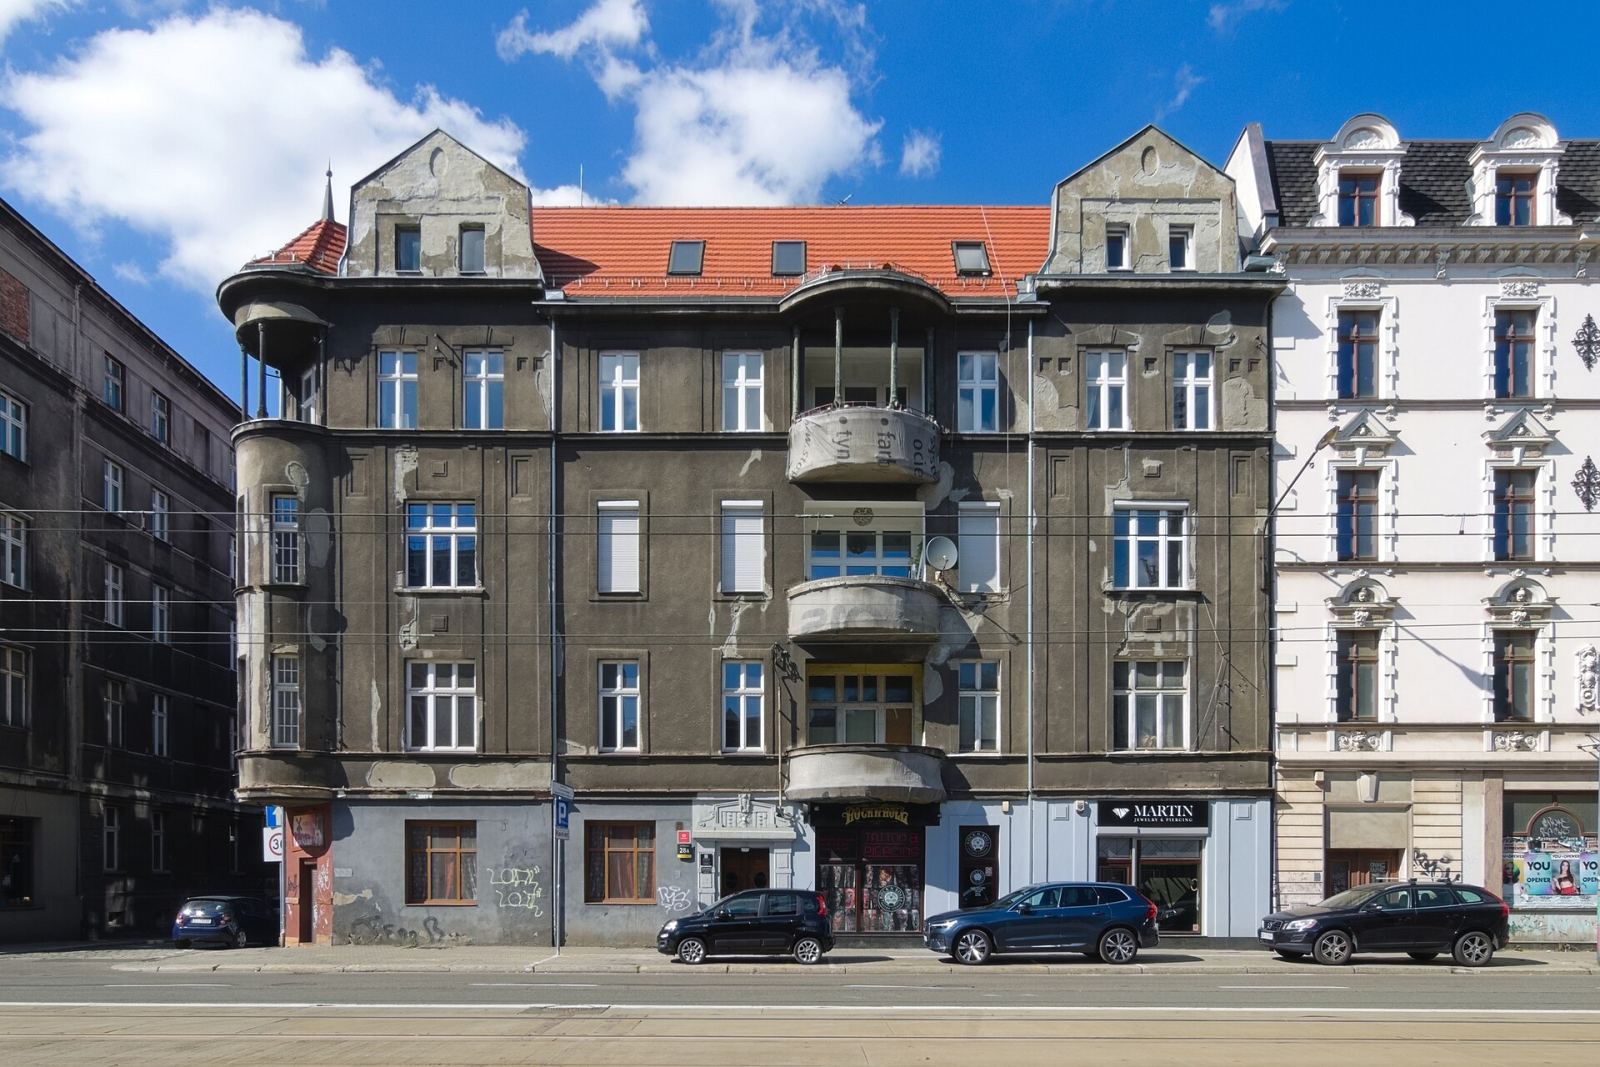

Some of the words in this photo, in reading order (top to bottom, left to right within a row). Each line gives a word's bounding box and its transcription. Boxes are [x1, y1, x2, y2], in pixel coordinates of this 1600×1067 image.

[558, 802, 567, 824] P
[1134, 805, 1193, 817] MARTIN
[1527, 861, 1551, 871] YOU
